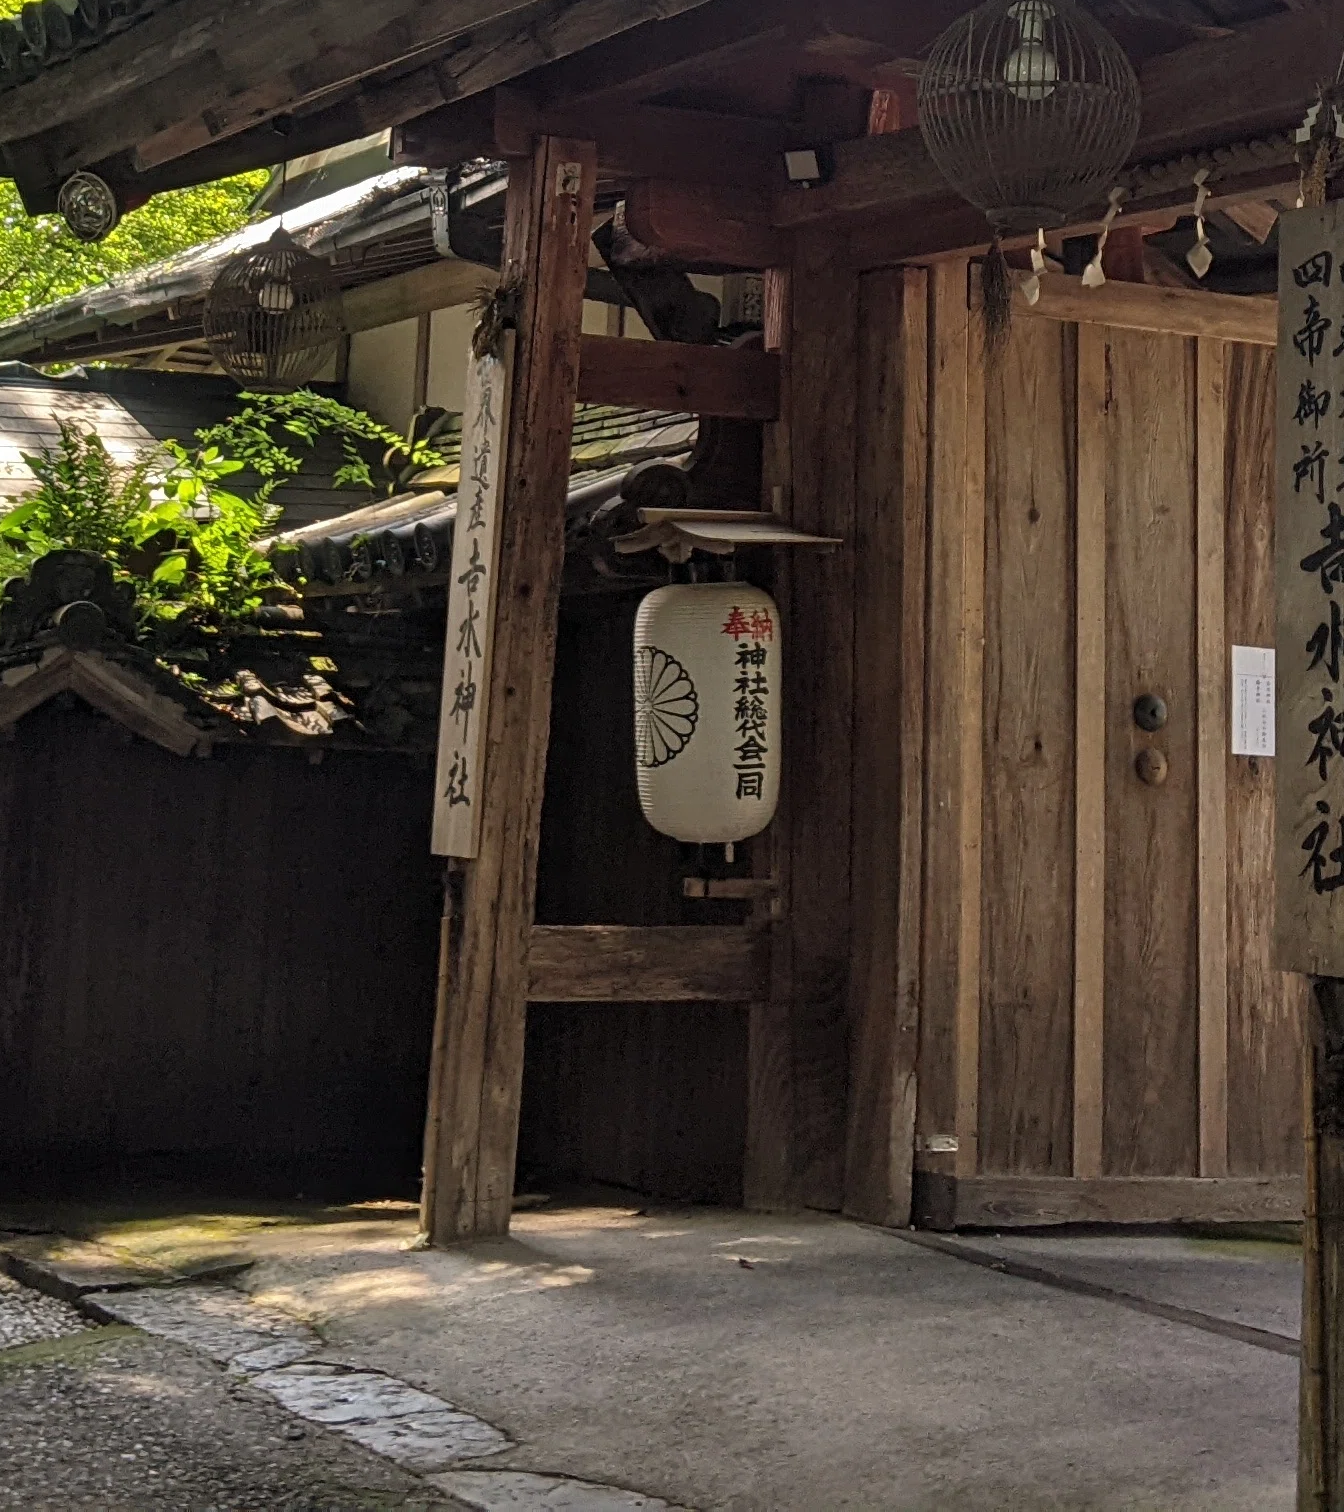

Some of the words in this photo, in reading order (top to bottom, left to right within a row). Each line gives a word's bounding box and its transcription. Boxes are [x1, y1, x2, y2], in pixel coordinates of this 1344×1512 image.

[1291, 250, 1333, 505] 四帝御所
[721, 605, 774, 642] 奉納
[732, 641, 770, 801] 神社総代会一同
